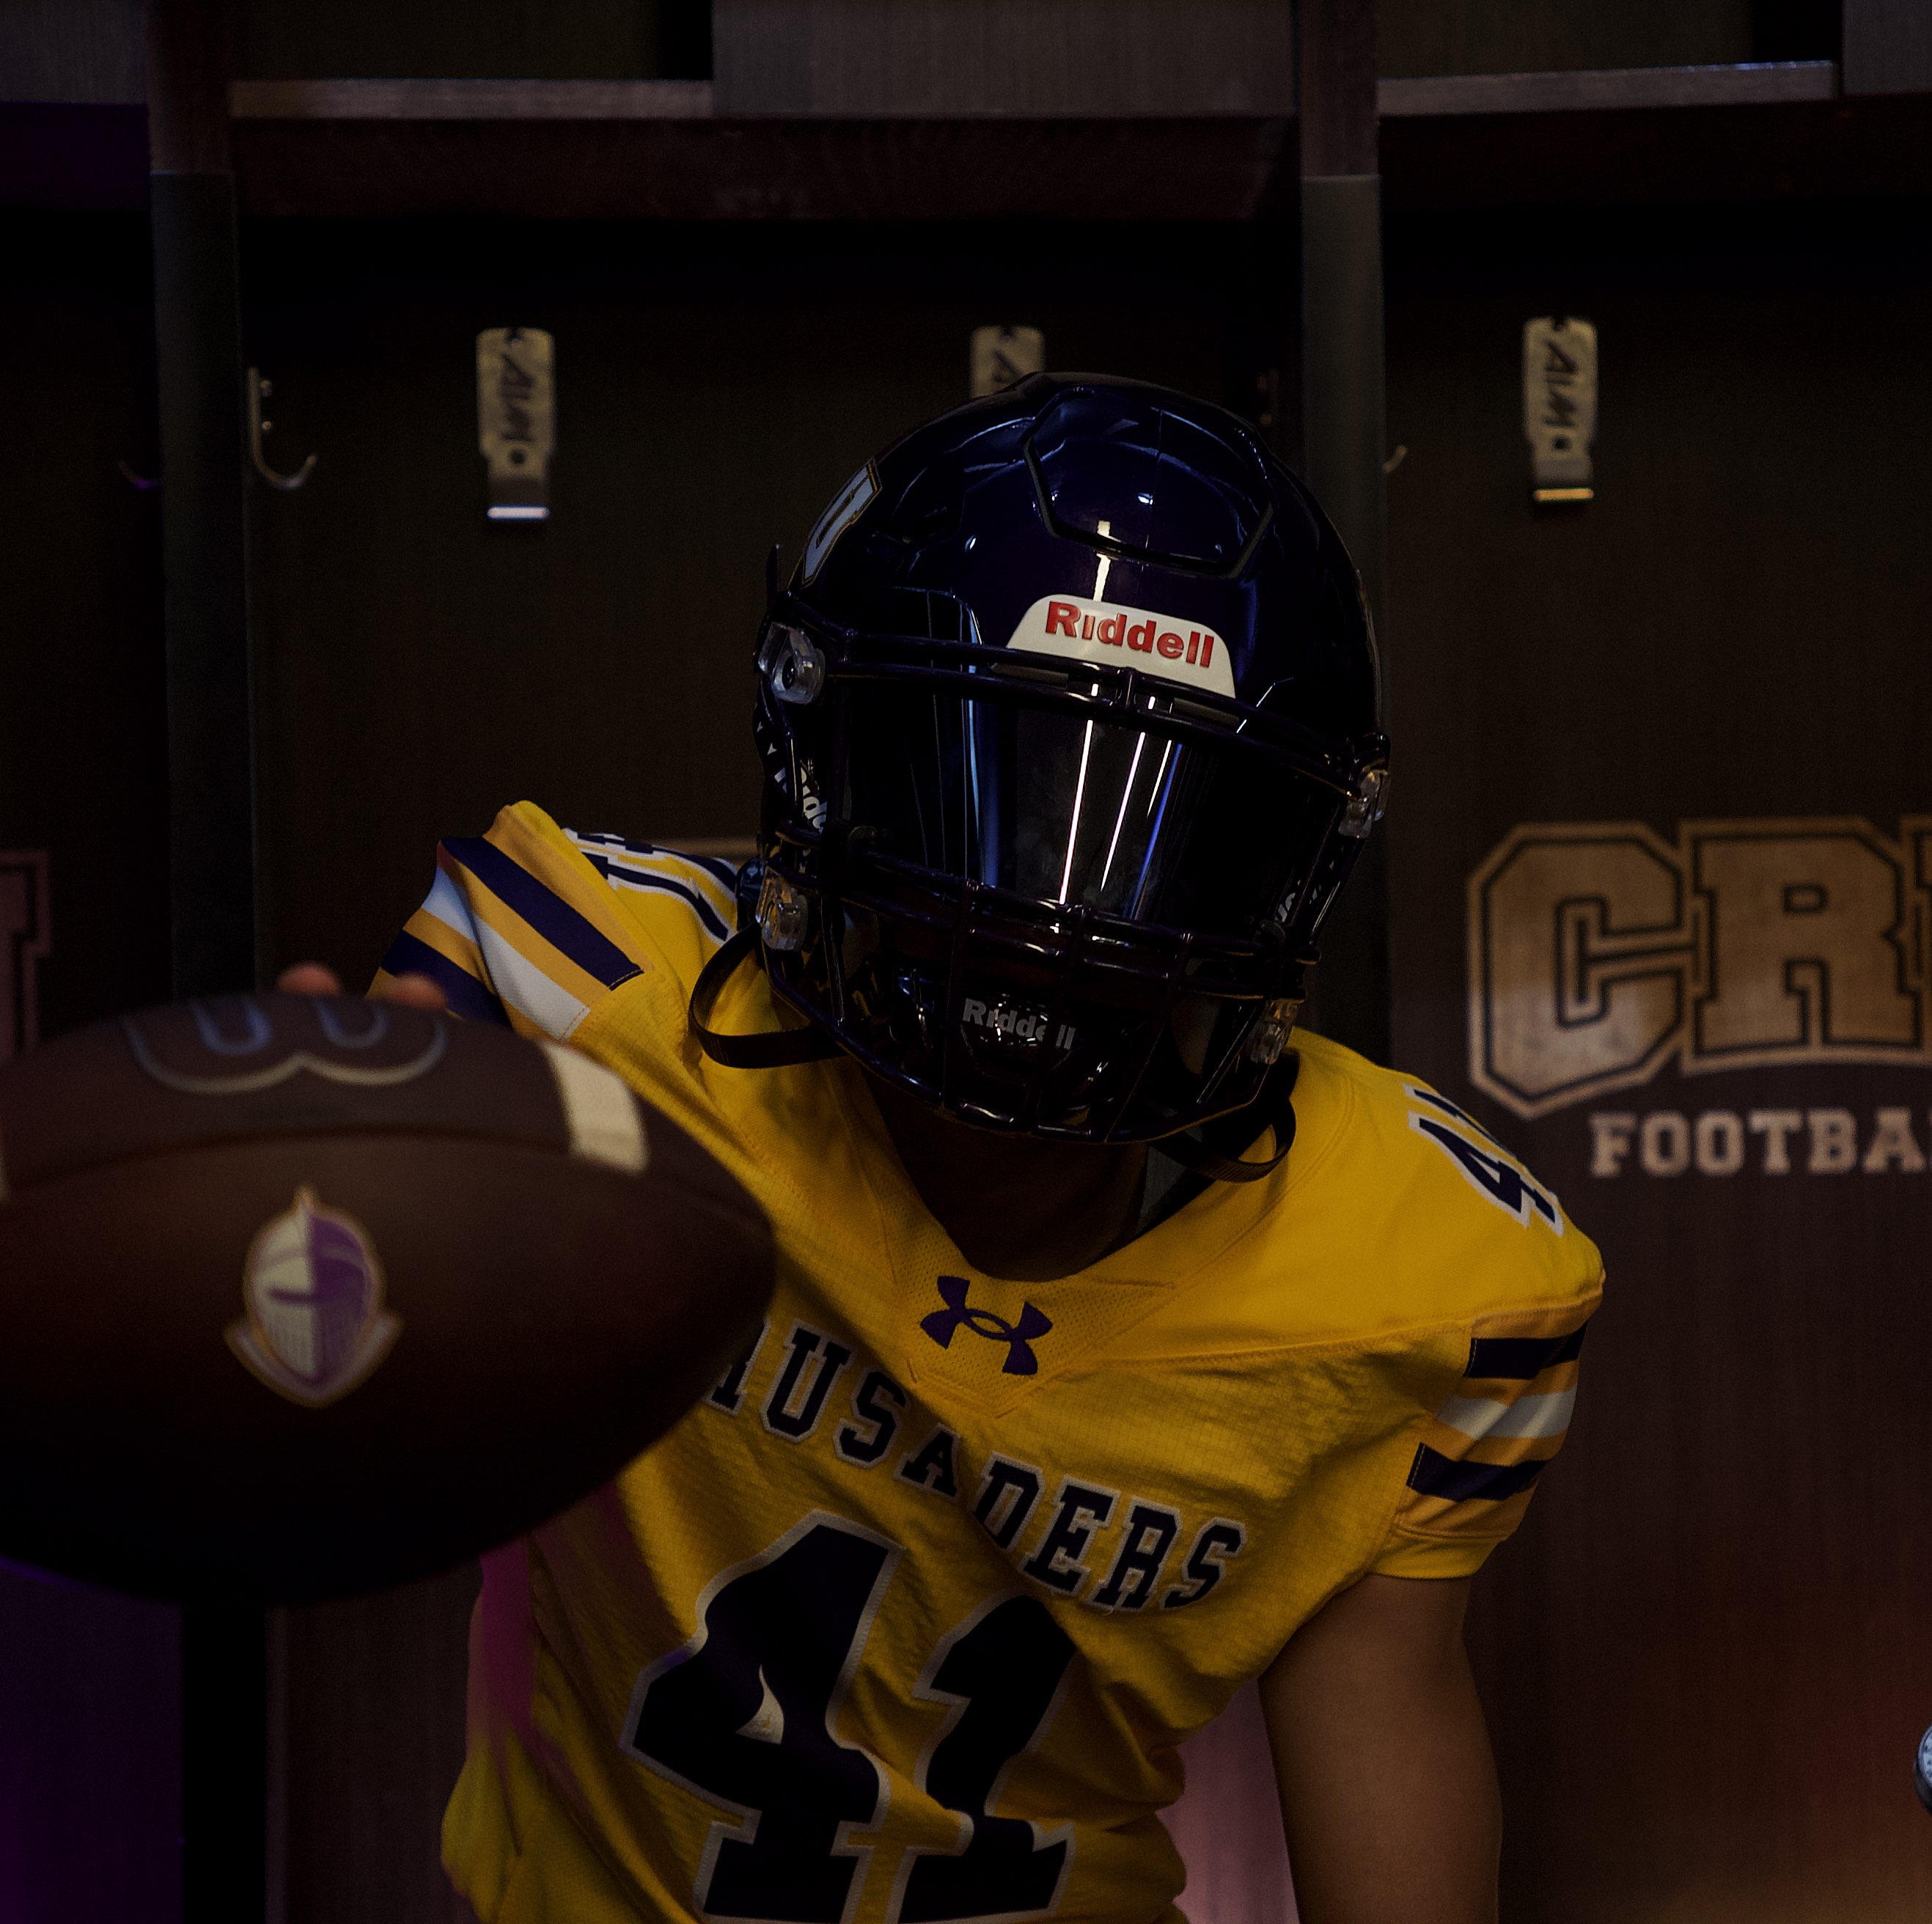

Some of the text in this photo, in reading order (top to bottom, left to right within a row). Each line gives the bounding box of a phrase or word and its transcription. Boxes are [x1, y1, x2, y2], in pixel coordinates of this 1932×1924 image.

[1045, 601, 1215, 668] Riddell
[1466, 818, 1932, 1121] CR
[1588, 1107, 1932, 1178] FOOTBA
[617, 1508, 1078, 1924] 41
